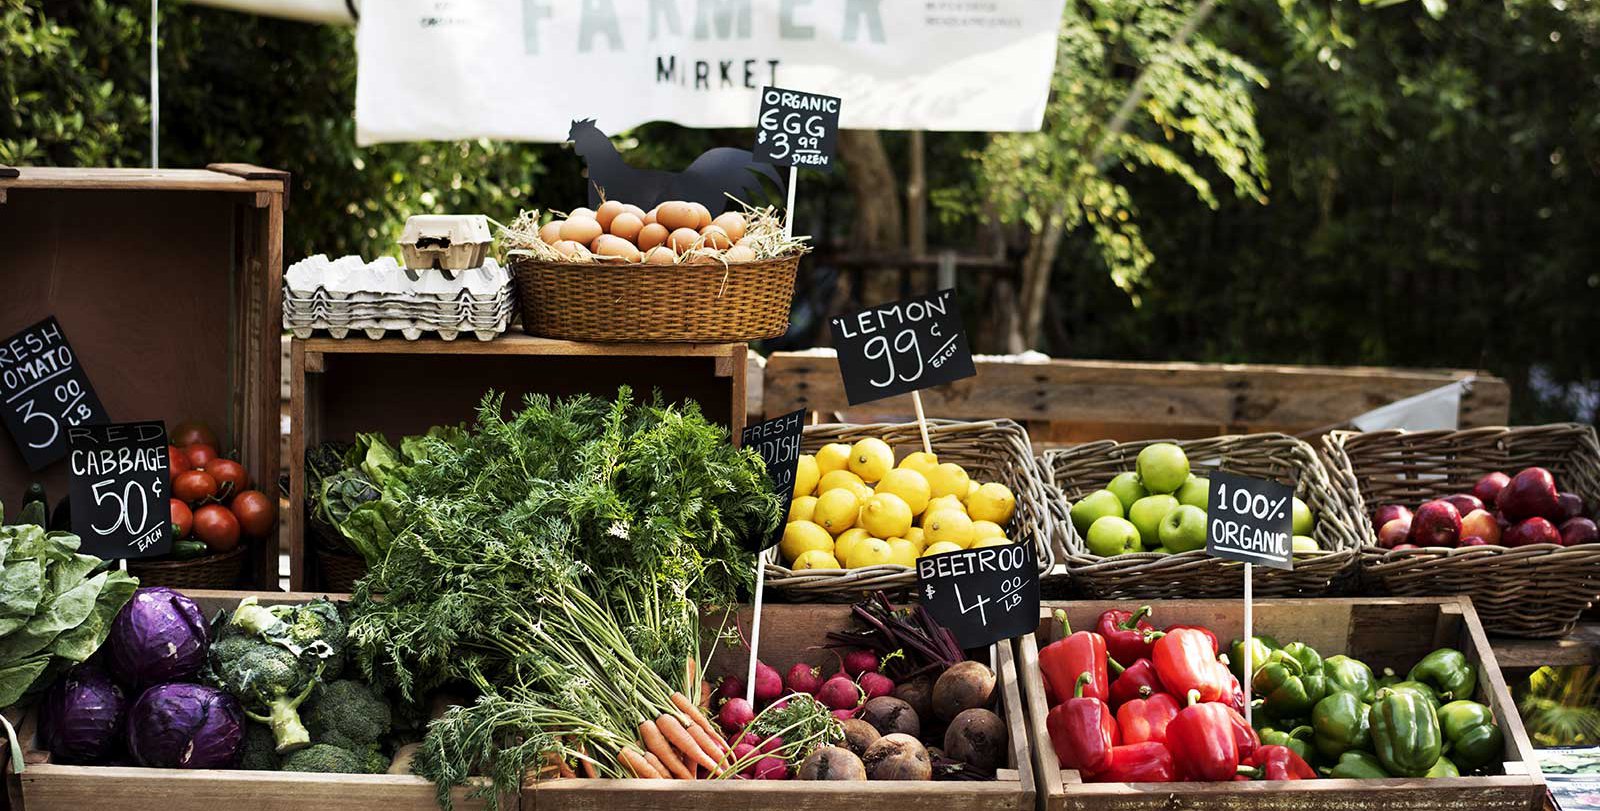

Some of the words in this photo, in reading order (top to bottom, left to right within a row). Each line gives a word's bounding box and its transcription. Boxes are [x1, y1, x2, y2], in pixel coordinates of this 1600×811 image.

[656, 55, 780, 88] MRKET
[765, 90, 837, 114] ORGANIC
[760, 108, 825, 138] EGG
[798, 136, 818, 149] 99
[791, 153, 828, 165] DOZEN
[0, 323, 62, 369] RESH
[863, 329, 924, 388] 99
[932, 342, 958, 369] EACH
[0, 345, 72, 395] OMATO
[15, 399, 59, 449] 3
[54, 379, 80, 403] 00
[68, 403, 92, 426] LB
[743, 414, 799, 443] FRESH
[68, 425, 165, 444] RED
[756, 433, 800, 465] DISH
[71, 446, 168, 476] CABBAGE
[91, 479, 148, 536] 50
[151, 477, 163, 498] ¢
[1217, 483, 1287, 521] 100%
[137, 528, 163, 552] EACH
[1212, 518, 1289, 556] ORGANIC
[919, 538, 1031, 580] BEETROOT
[924, 583, 936, 600] $
[954, 582, 991, 626] 4
[1000, 576, 1021, 593] 00
[1004, 592, 1022, 612] LB
